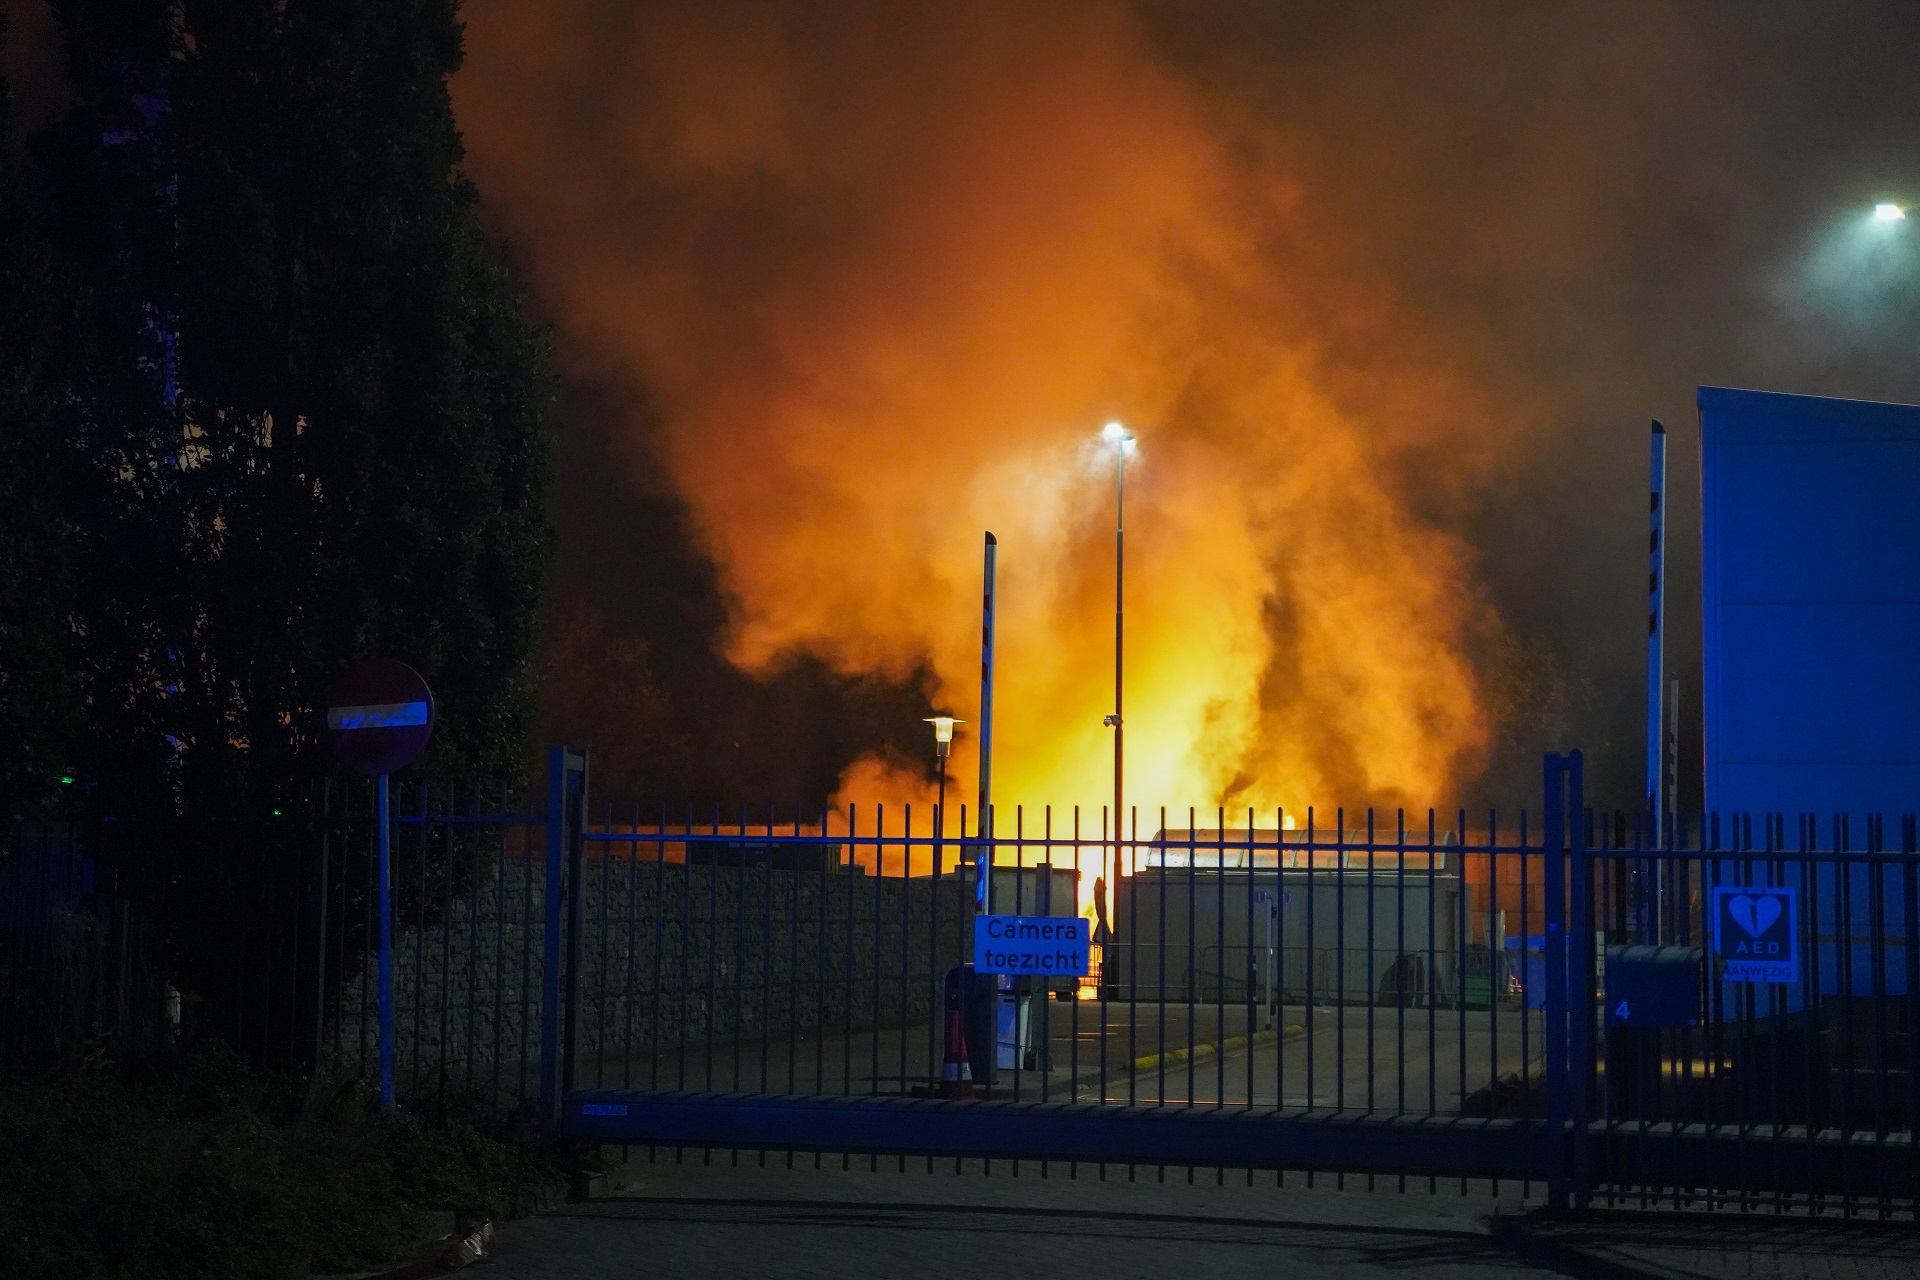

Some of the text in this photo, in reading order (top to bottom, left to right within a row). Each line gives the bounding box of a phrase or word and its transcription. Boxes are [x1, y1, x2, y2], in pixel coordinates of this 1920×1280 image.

[987, 919, 1077, 940] Camera
[1736, 941, 1779, 954] AED
[984, 949, 1080, 970] toezicht
[1615, 1001, 1630, 1020] 4
